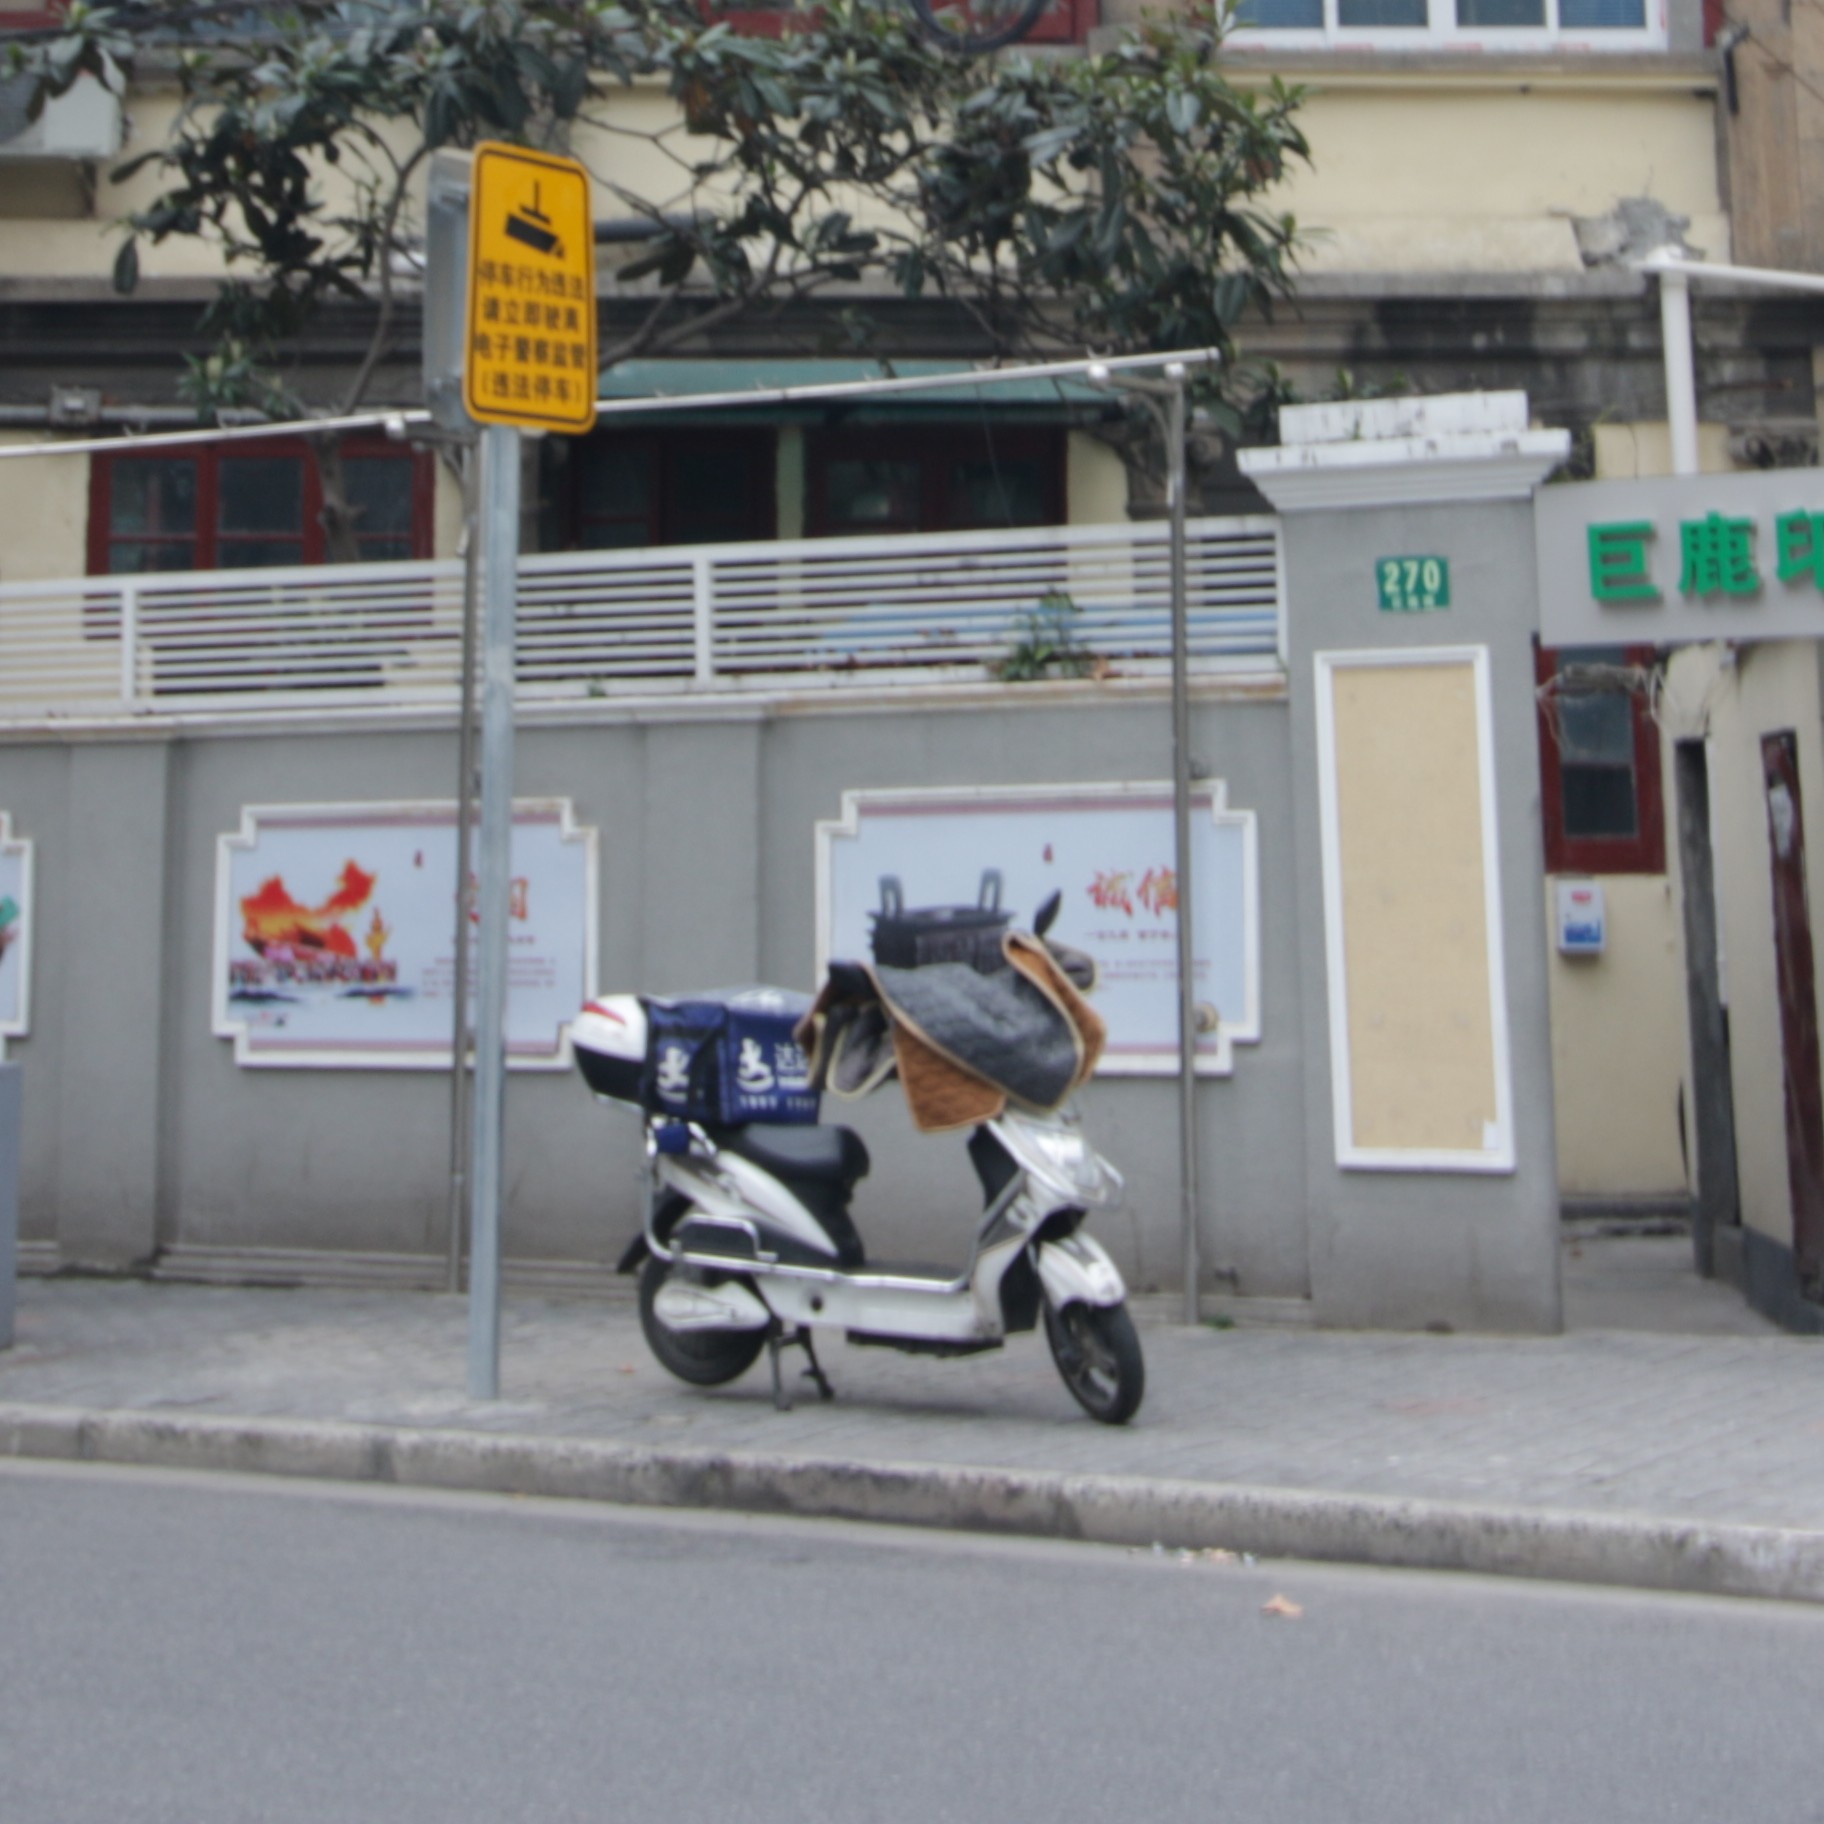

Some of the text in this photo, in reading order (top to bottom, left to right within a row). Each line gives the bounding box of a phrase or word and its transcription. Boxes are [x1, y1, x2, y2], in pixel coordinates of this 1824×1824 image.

[483, 295, 579, 332] 请立即驶离
[1383, 558, 1441, 593] 270
